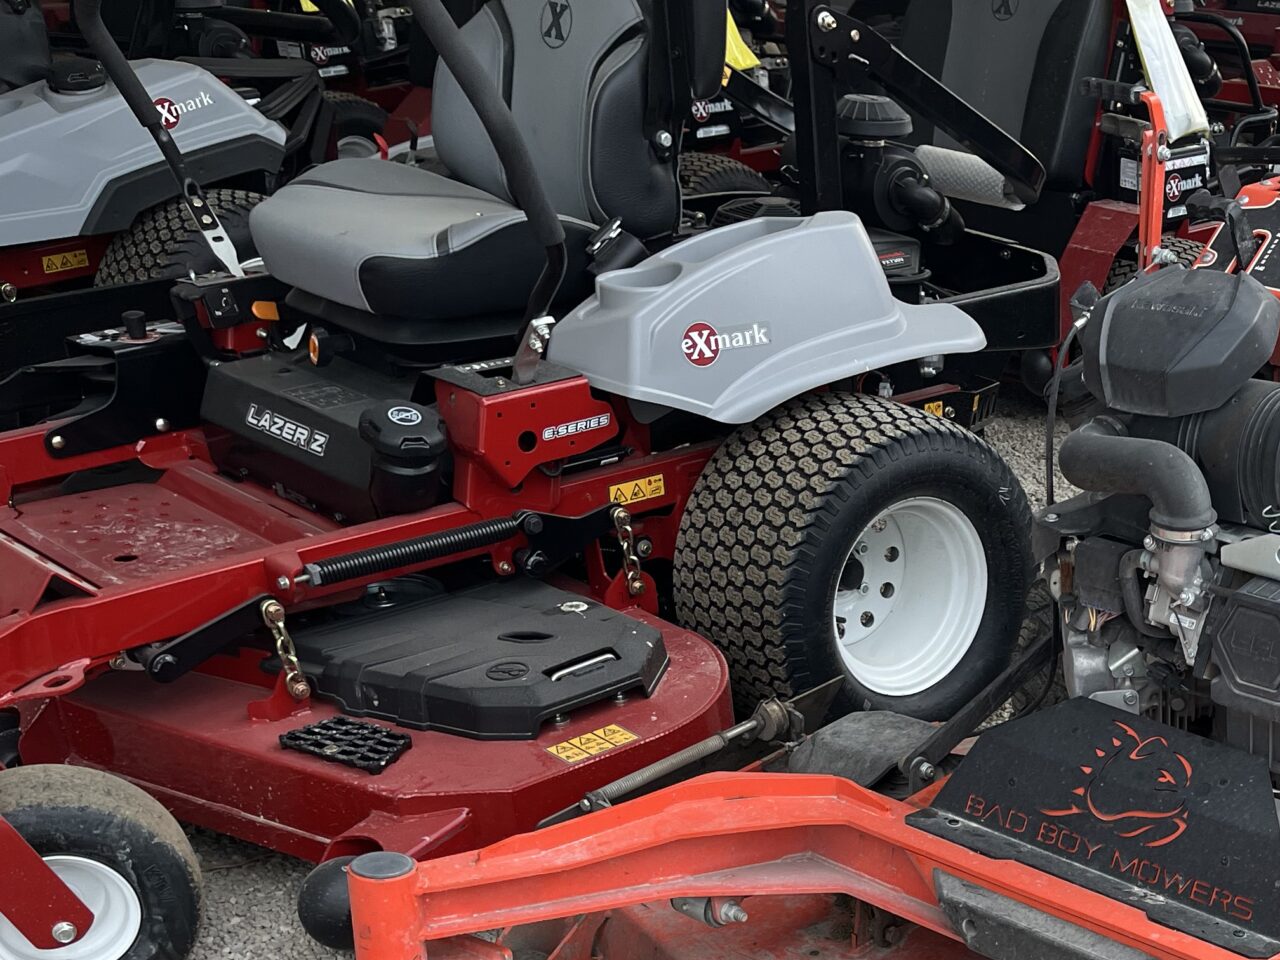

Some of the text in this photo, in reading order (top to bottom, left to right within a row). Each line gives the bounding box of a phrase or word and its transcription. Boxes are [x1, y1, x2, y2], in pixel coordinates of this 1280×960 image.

[311, 46, 351, 61] eXmark
[155, 91, 213, 125] Xmark
[691, 98, 734, 118] eXmark
[1165, 173, 1203, 198] eXmark
[681, 322, 770, 361] eXmark
[246, 403, 330, 457] LAZER Z
[965, 793, 1255, 922] BAD BOY MOWERS
